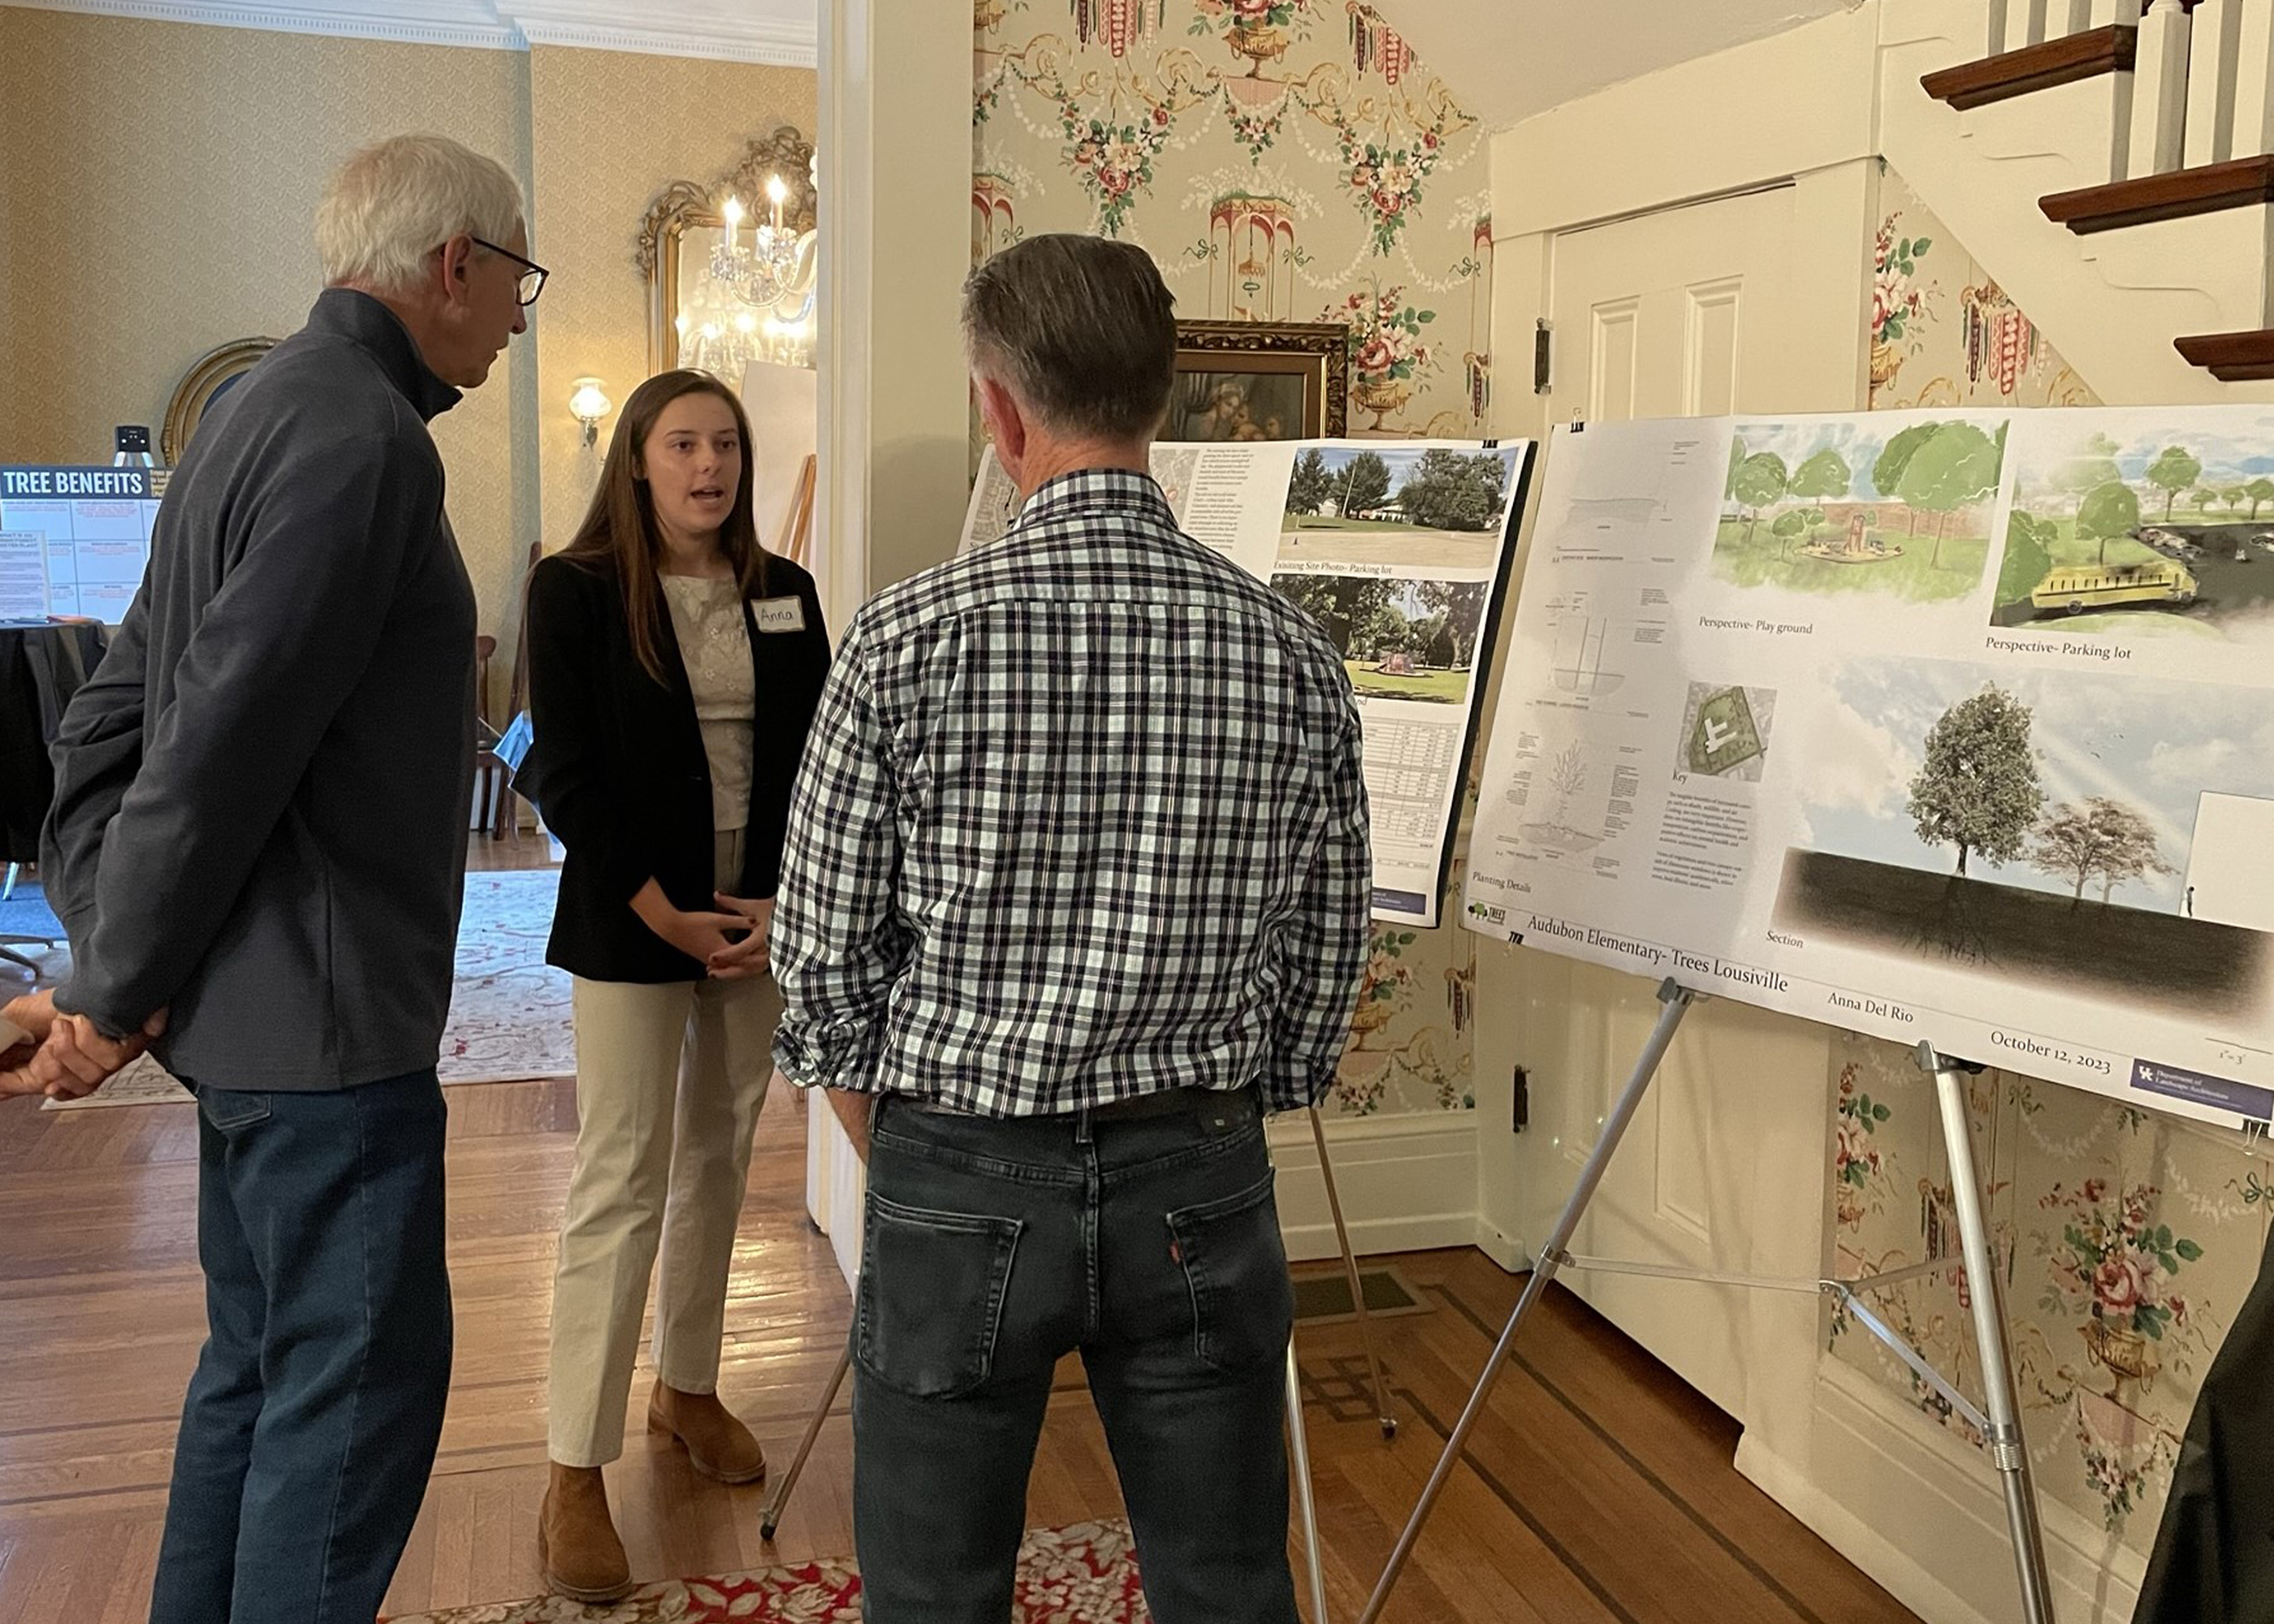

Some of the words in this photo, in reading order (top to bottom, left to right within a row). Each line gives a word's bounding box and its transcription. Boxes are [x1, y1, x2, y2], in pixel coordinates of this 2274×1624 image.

[3, 471, 51, 494] TREE
[55, 472, 143, 495] BENEFITS
[1306, 561, 1320, 570] Site
[1350, 564, 1380, 575] Parking
[1381, 564, 1393, 574] lot
[761, 608, 793, 622] Anna
[1699, 616, 1753, 629] Perspective-
[1776, 623, 1814, 634] ground
[1985, 637, 2059, 653] Perspective-
[2062, 642, 2110, 660] Parking
[2114, 646, 2132, 659] lot
[1672, 769, 1688, 785] Key
[1472, 871, 1506, 889] Planting
[1507, 879, 1532, 893] Details
[1766, 929, 1804, 948] Section
[1528, 915, 1584, 941] Audubon
[1587, 928, 1667, 965] Elementary-
[1671, 948, 1710, 973] Trees
[1713, 959, 1788, 992] Lousiville
[1827, 991, 1861, 1011] Anna
[1865, 1000, 1887, 1017] Del
[1891, 1006, 1914, 1023] Rio
[1991, 1030, 2051, 1057] October
[2054, 1049, 2072, 1064] 12,
[2076, 1055, 2112, 1075] 2023
